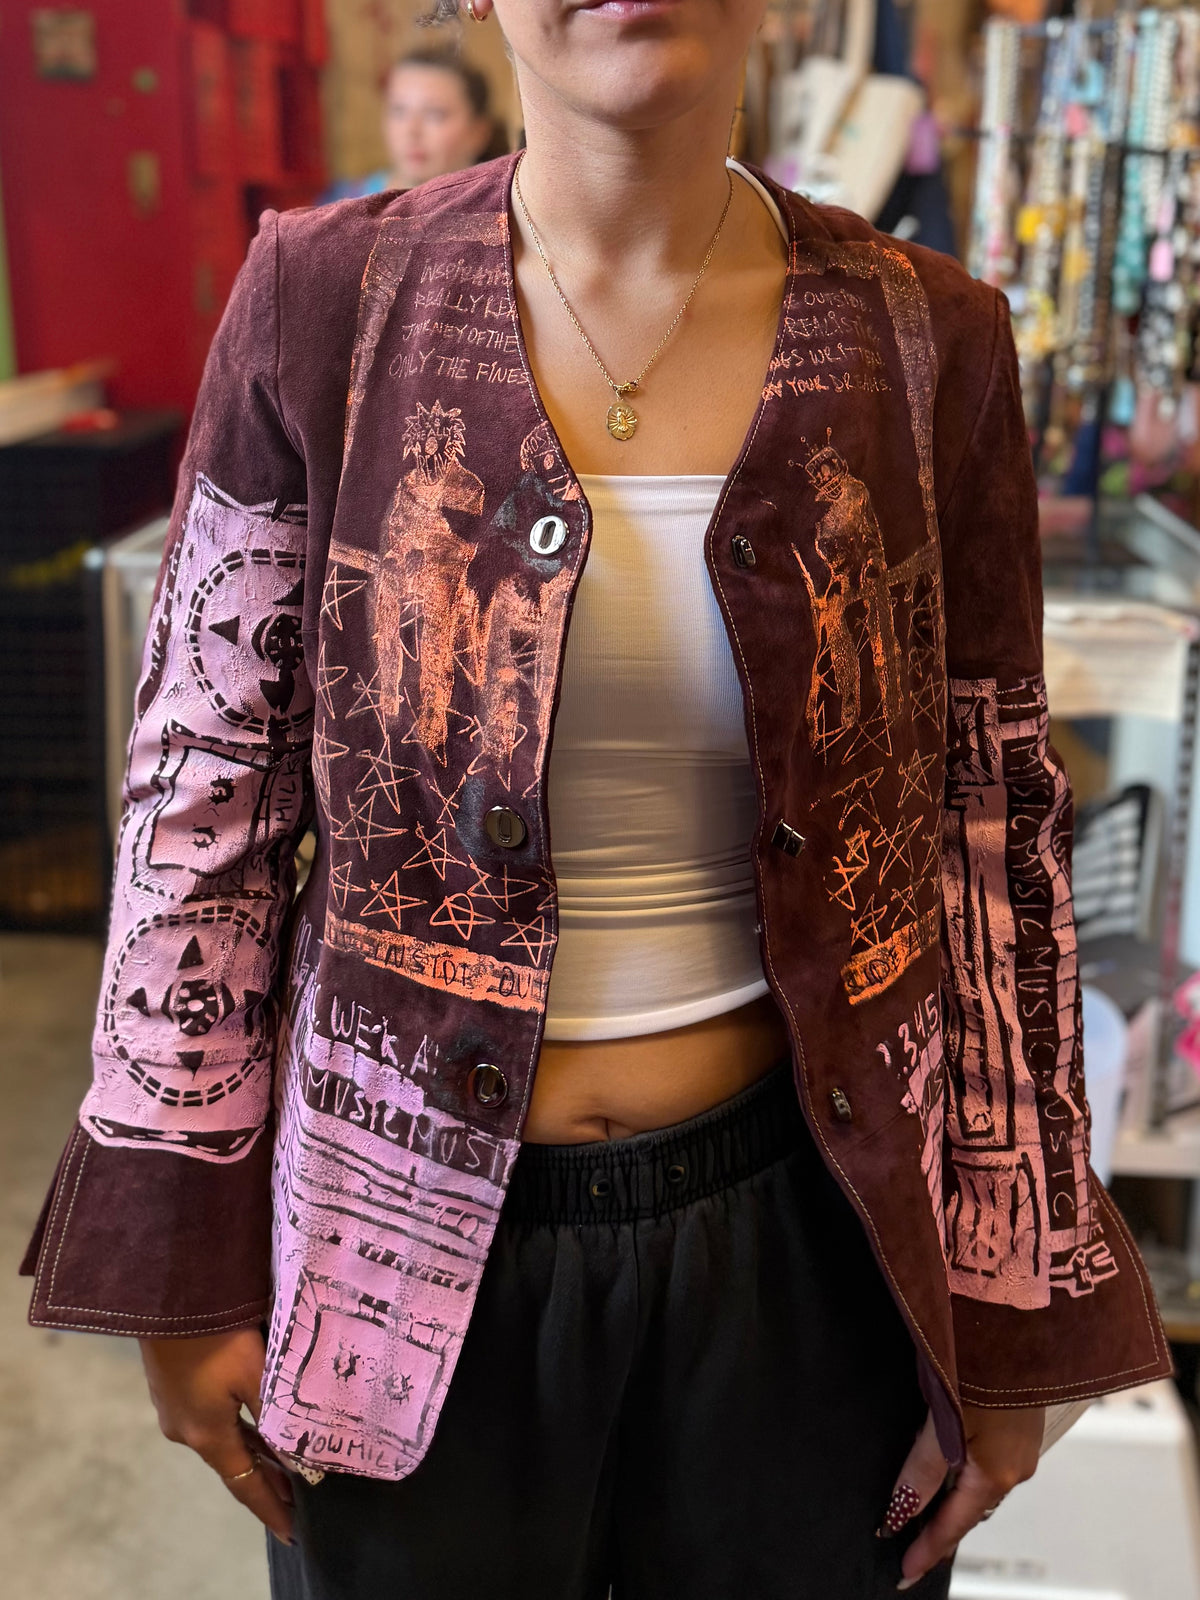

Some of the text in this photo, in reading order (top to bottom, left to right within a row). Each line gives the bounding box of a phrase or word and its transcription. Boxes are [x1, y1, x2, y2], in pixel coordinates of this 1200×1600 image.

[436, 355, 471, 380] THE
[786, 374, 829, 398] YOUR
[1016, 945, 1056, 1059] MUSIC
